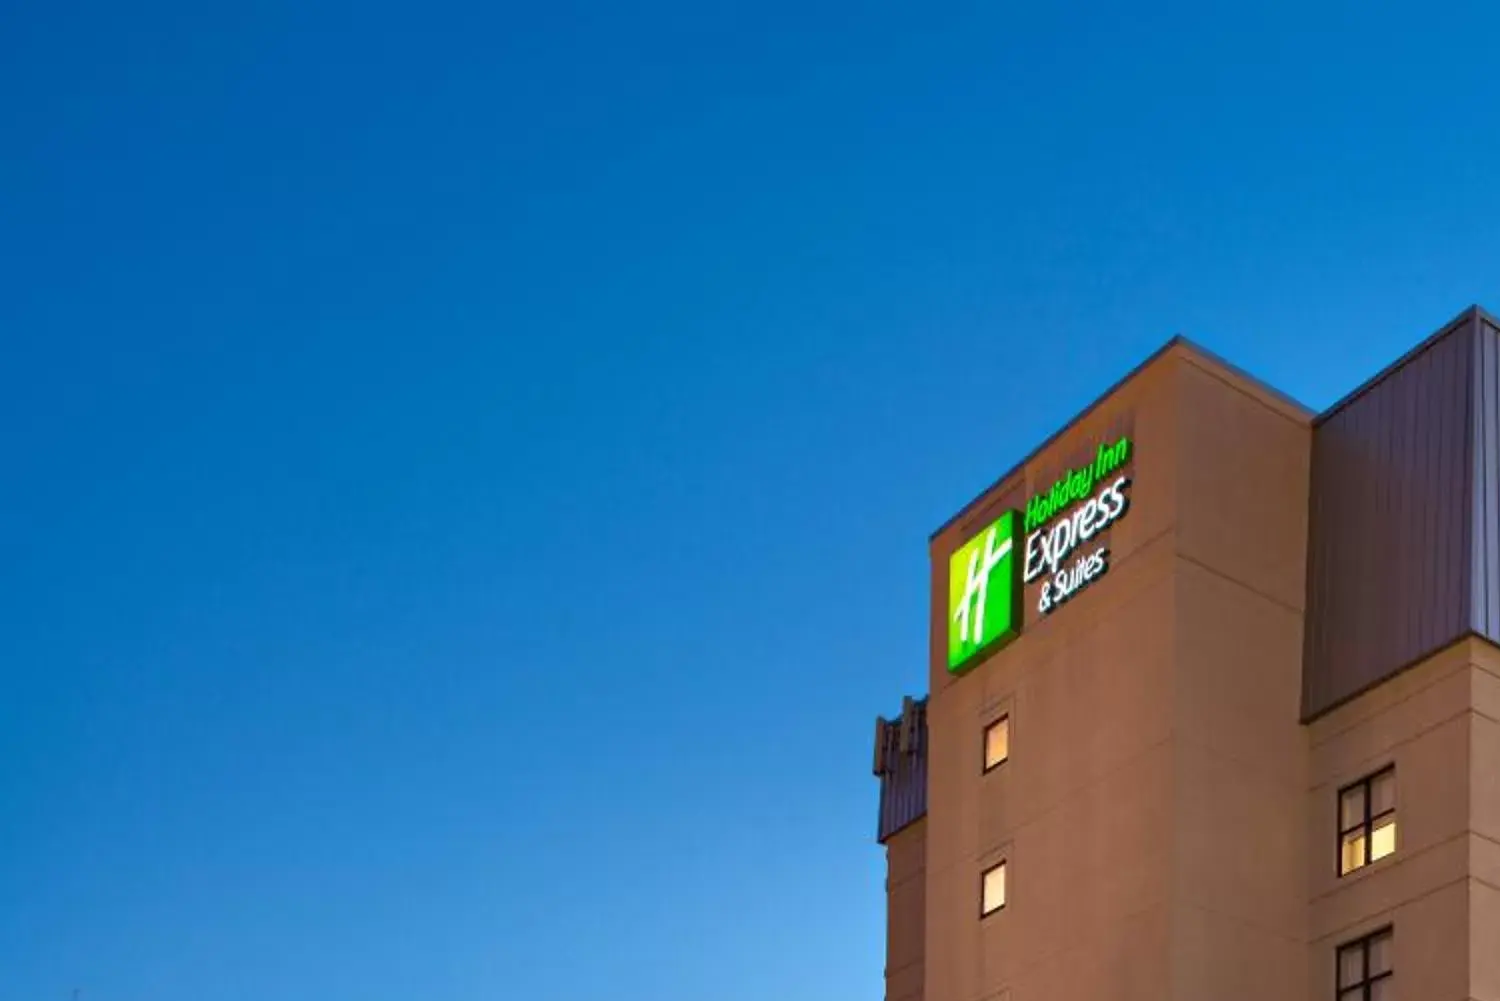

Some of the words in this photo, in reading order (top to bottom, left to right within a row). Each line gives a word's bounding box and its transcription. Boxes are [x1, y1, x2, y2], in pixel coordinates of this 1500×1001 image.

[1024, 463, 1094, 532] Holiday
[1095, 437, 1128, 479] Inn
[1024, 476, 1126, 582] Express
[953, 527, 1013, 645] H
[1038, 580, 1052, 612] &
[1053, 547, 1106, 603] Suites
